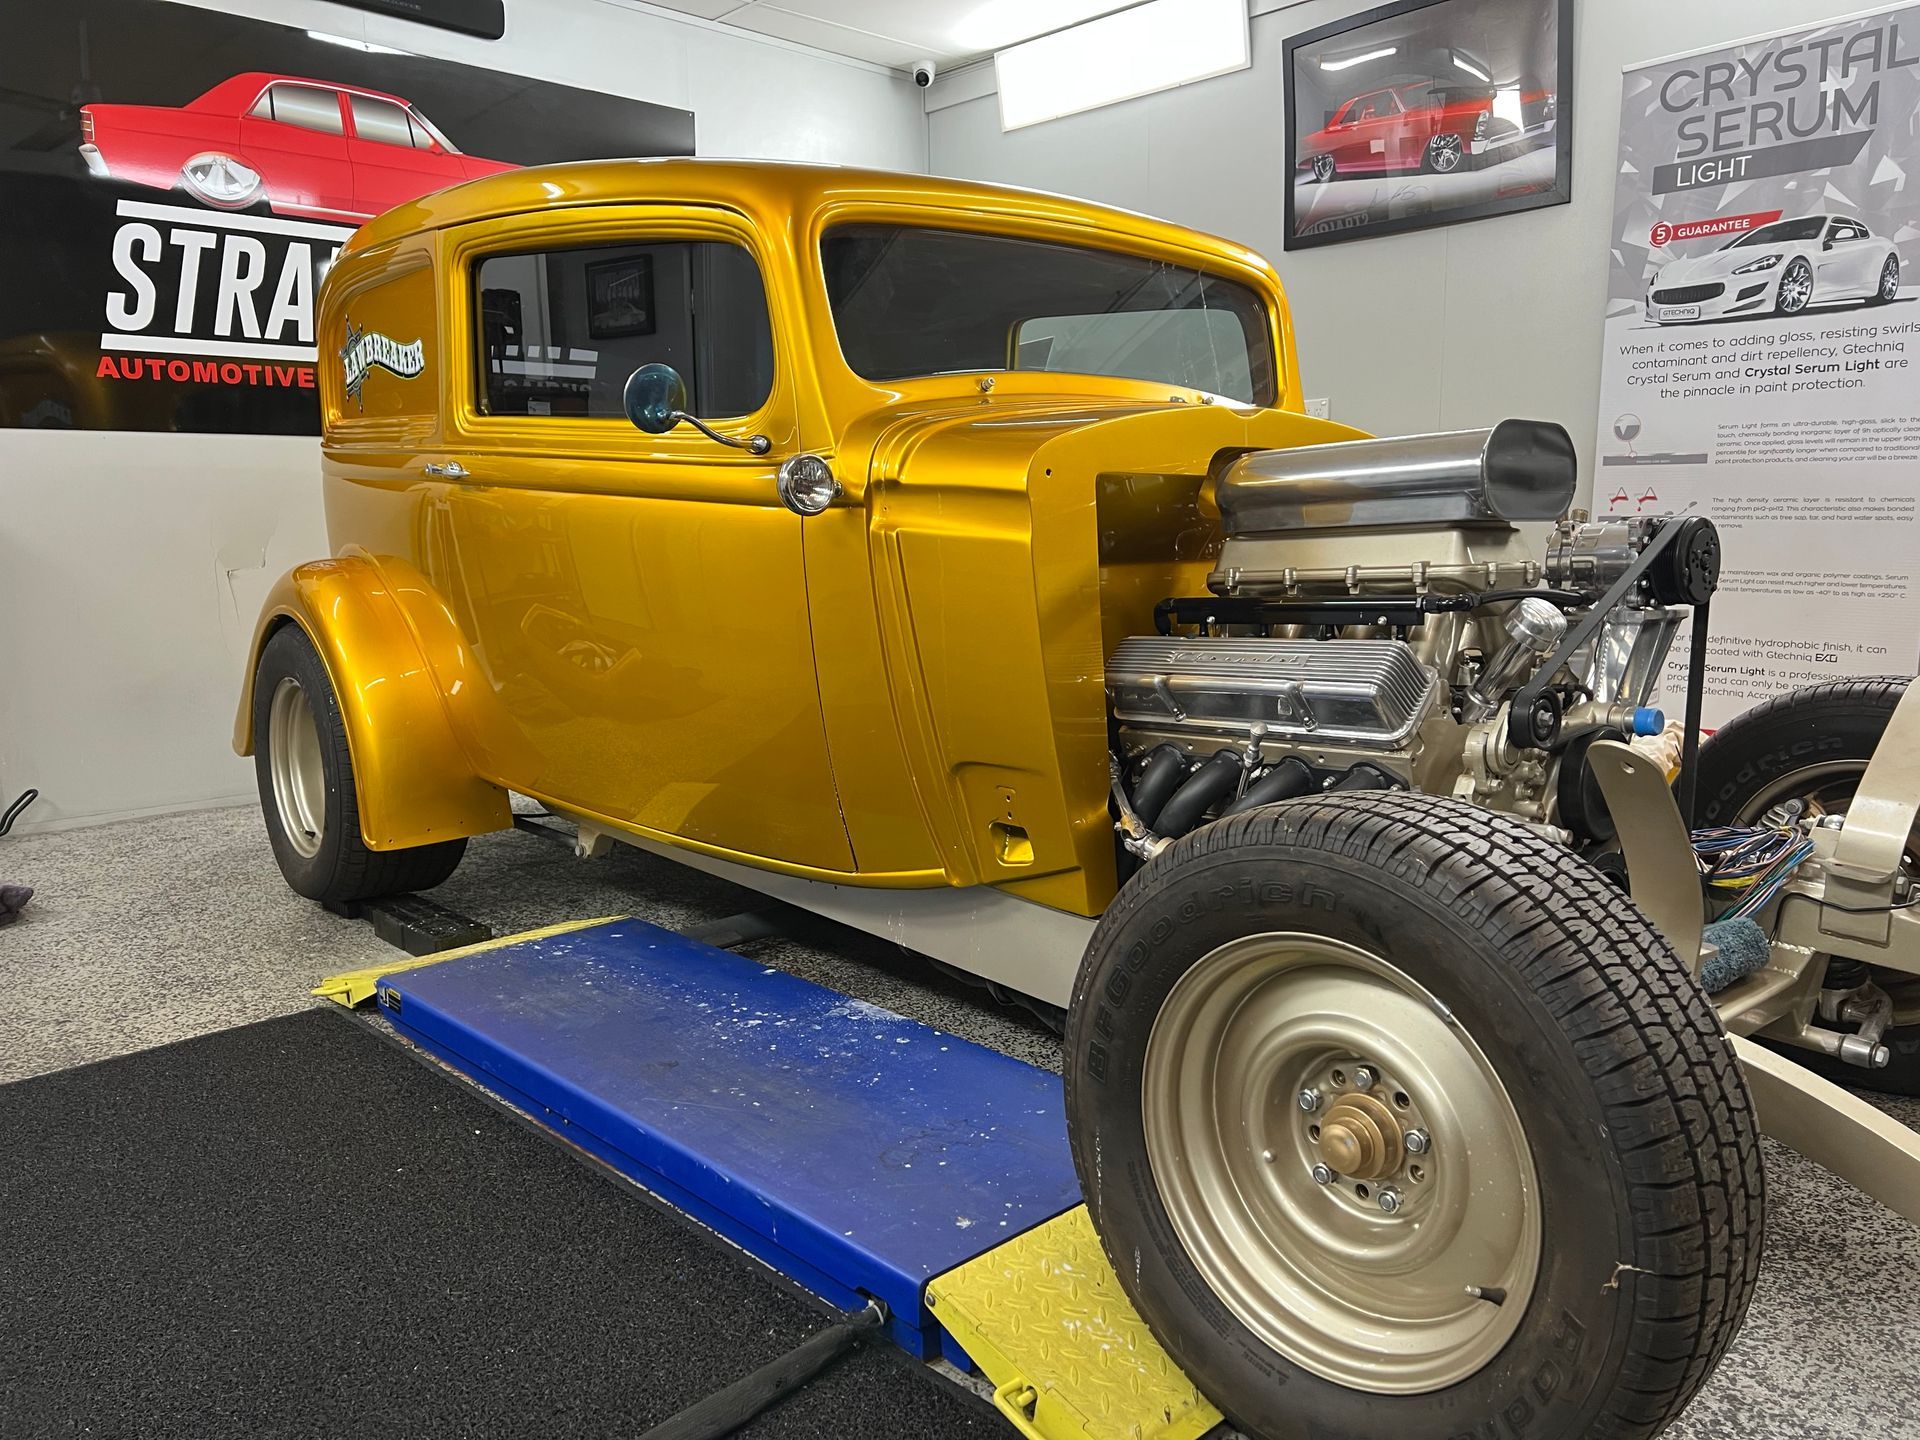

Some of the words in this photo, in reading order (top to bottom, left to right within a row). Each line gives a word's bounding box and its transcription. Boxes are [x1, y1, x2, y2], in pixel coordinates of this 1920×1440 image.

[1659, 23, 1920, 113] CRYSTAL
[1676, 80, 1880, 159] SERUM
[1676, 155, 1752, 188] LIGHT
[1677, 218, 1750, 237] GUARANTEE
[106, 223, 330, 342] STRA
[1620, 345, 1653, 355] When
[1658, 343, 1665, 352] it
[1669, 342, 1708, 352] comes
[1713, 339, 1725, 348] to
[1730, 336, 1774, 347] adding
[1780, 333, 1815, 346] gloss,
[1821, 328, 1877, 340] resisting
[343, 332, 425, 387] LAWBREAKER
[1632, 355, 1708, 370] contaminant
[1712, 353, 1736, 364] and
[1741, 351, 1763, 362] dirt
[1768, 349, 1838, 362] repellency,
[1843, 342, 1904, 355] Gtechniq
[96, 355, 316, 389] AUTOMOTIVE
[1627, 373, 1668, 386] Crystal
[1673, 373, 1710, 382] Serum
[1715, 369, 1740, 380] and
[1745, 366, 1790, 379] Crystal
[1795, 365, 1840, 375] Serum
[1846, 360, 1880, 373] Light
[1885, 361, 1908, 369] are
[1660, 388, 1680, 398] the
[1684, 385, 1735, 399] pinnacle
[1740, 385, 1750, 394] in
[1755, 382, 1788, 395] paint
[1792, 379, 1866, 393] protection.
[1708, 634, 1752, 646] definitive
[1755, 637, 1820, 650] hydrophobic
[1823, 641, 1852, 652] finish,
[1857, 643, 1863, 652] it
[1743, 648, 1763, 658] with
[1766, 649, 1812, 663] Gtechniq
[1668, 662, 1688, 671] Crys
[1704, 663, 1736, 673] Serum
[1741, 665, 1765, 676] Light
[1769, 667, 1776, 676] is
[1708, 675, 1727, 684] and
[1730, 678, 1750, 686] can
[1750, 678, 1773, 690] only
[1776, 679, 1789, 689] be
